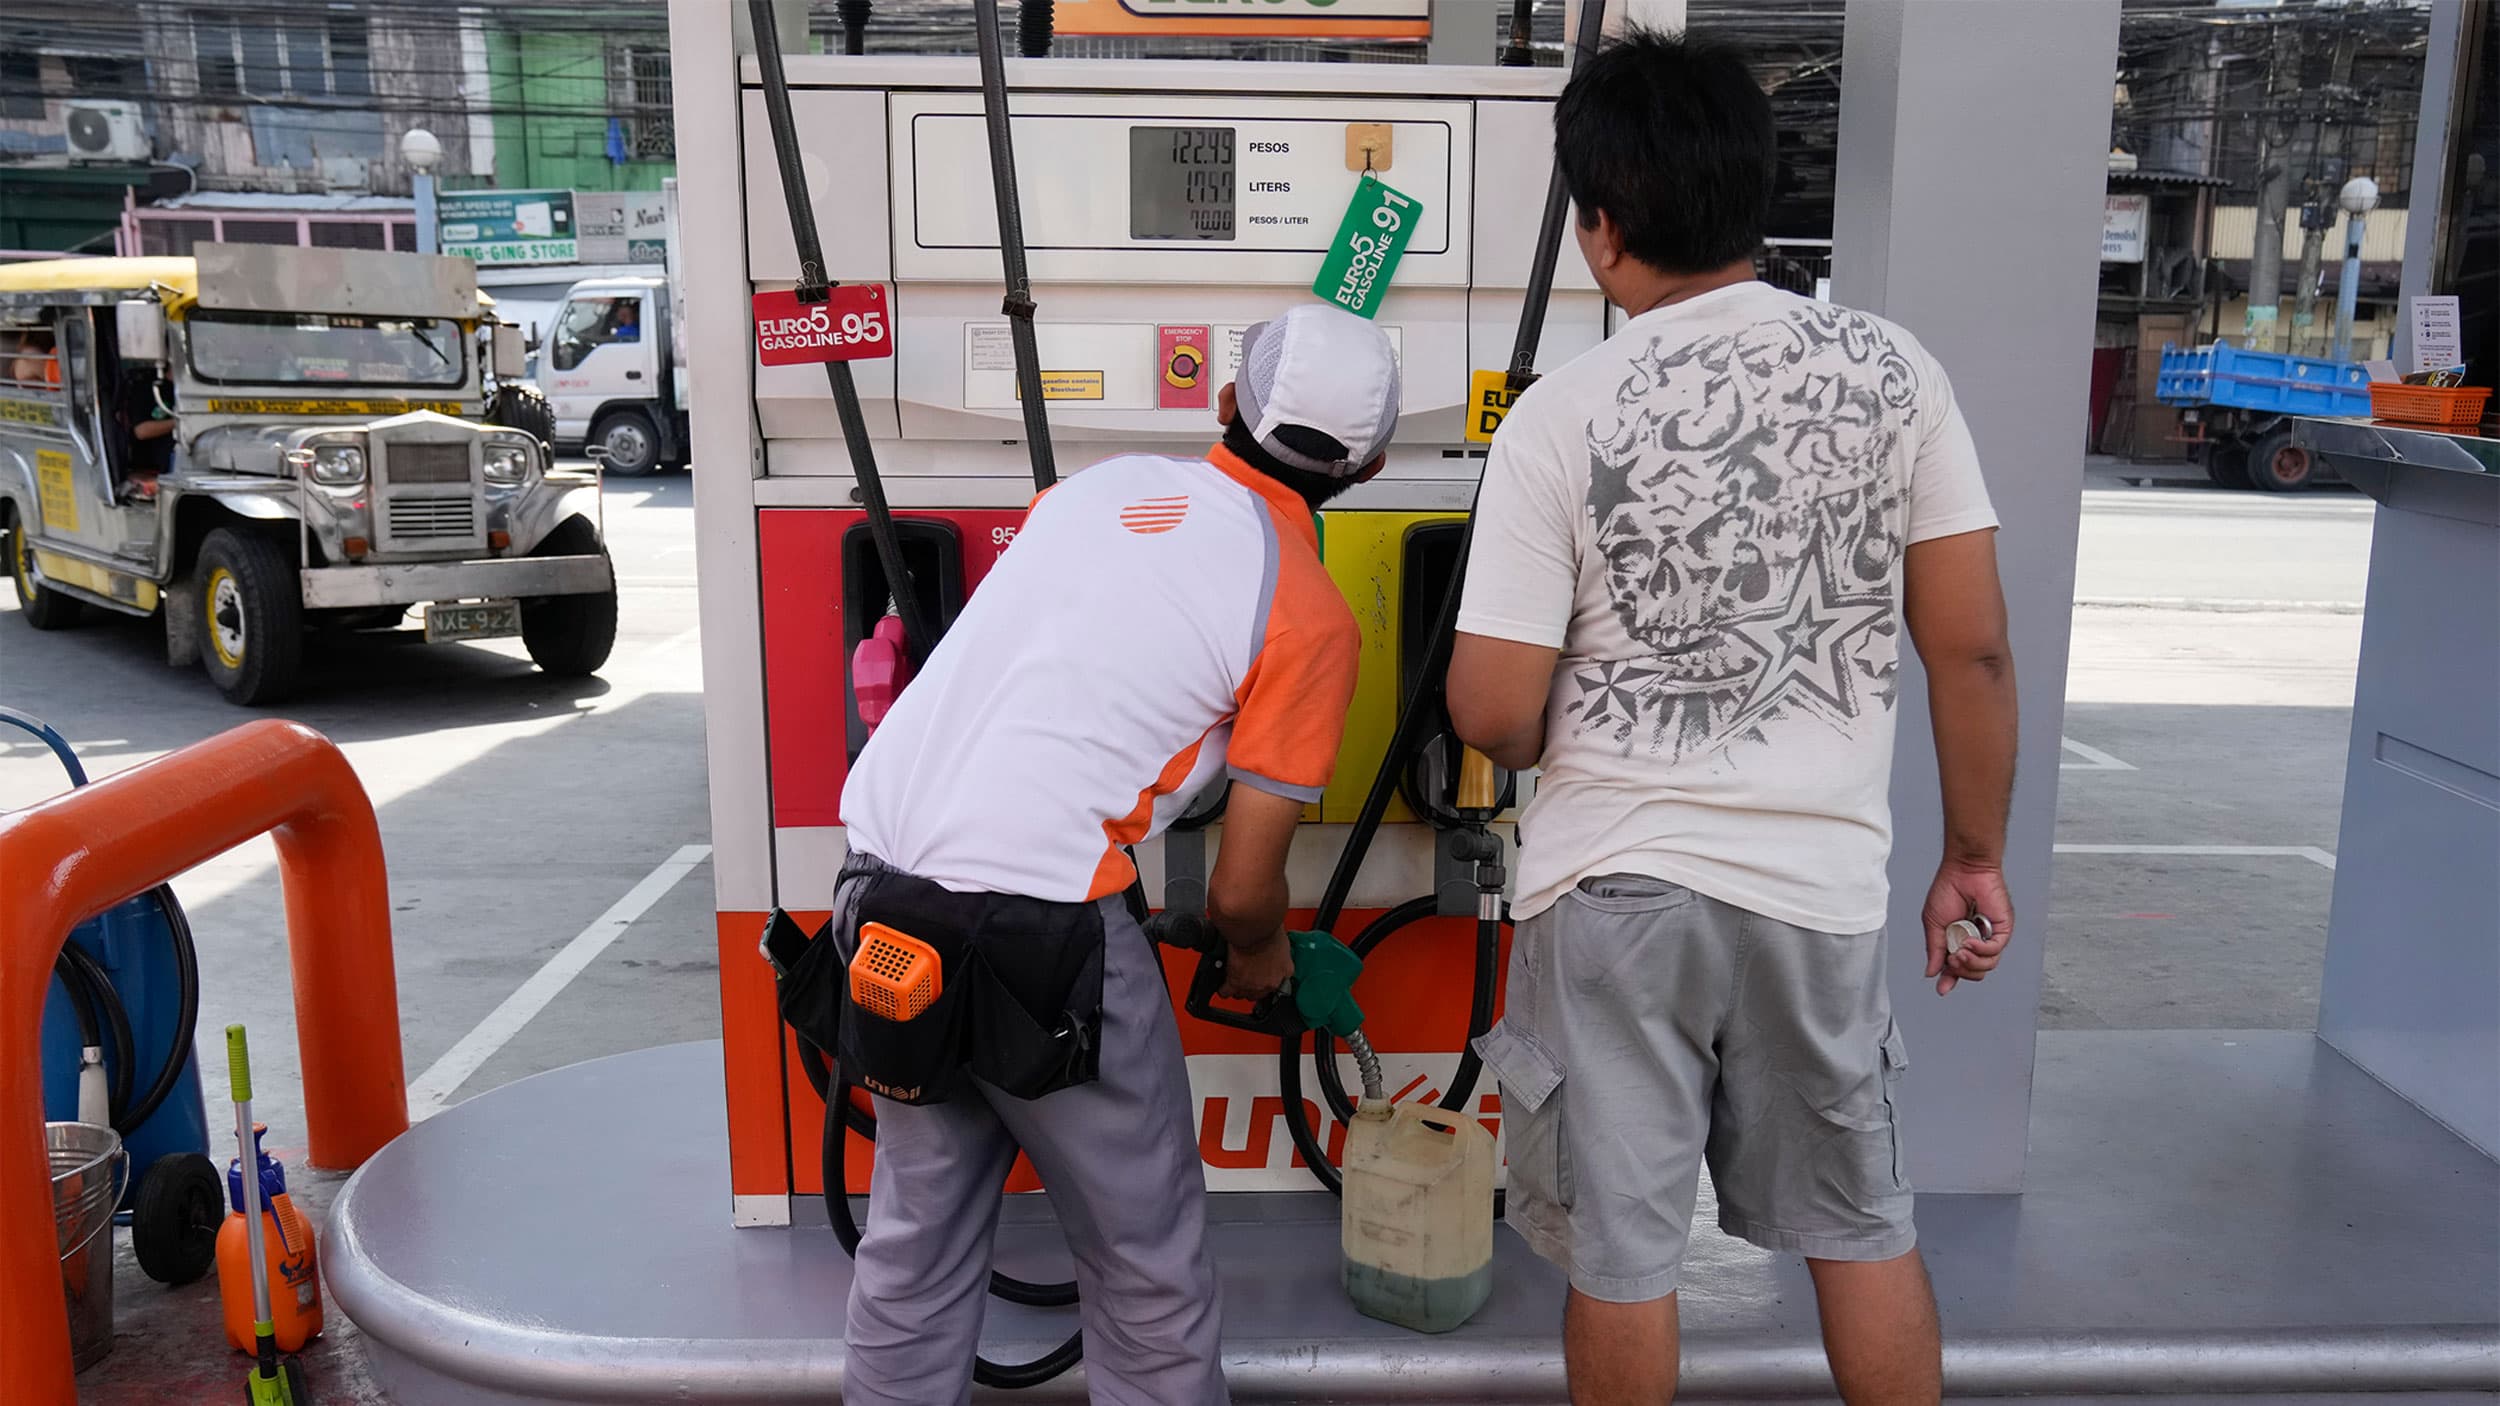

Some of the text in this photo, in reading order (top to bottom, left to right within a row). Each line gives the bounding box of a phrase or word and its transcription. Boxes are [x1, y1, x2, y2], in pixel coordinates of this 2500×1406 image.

[1249, 142, 1290, 153] PESOS
[1249, 182, 1291, 193] LITERS
[1372, 190, 1410, 232] 91
[1249, 216, 1278, 225] PESOS
[1284, 216, 1309, 225] LITER
[530, 242, 576, 259] STORE
[1335, 231, 1375, 305] EURO5
[1351, 233, 1393, 310] GASOLINE
[758, 306, 830, 337] EURO5
[841, 311, 885, 344] 95
[761, 332, 844, 350] GASOLINE
[1164, 328, 1204, 336] EMERGENCY
[991, 527, 1016, 545] 95
